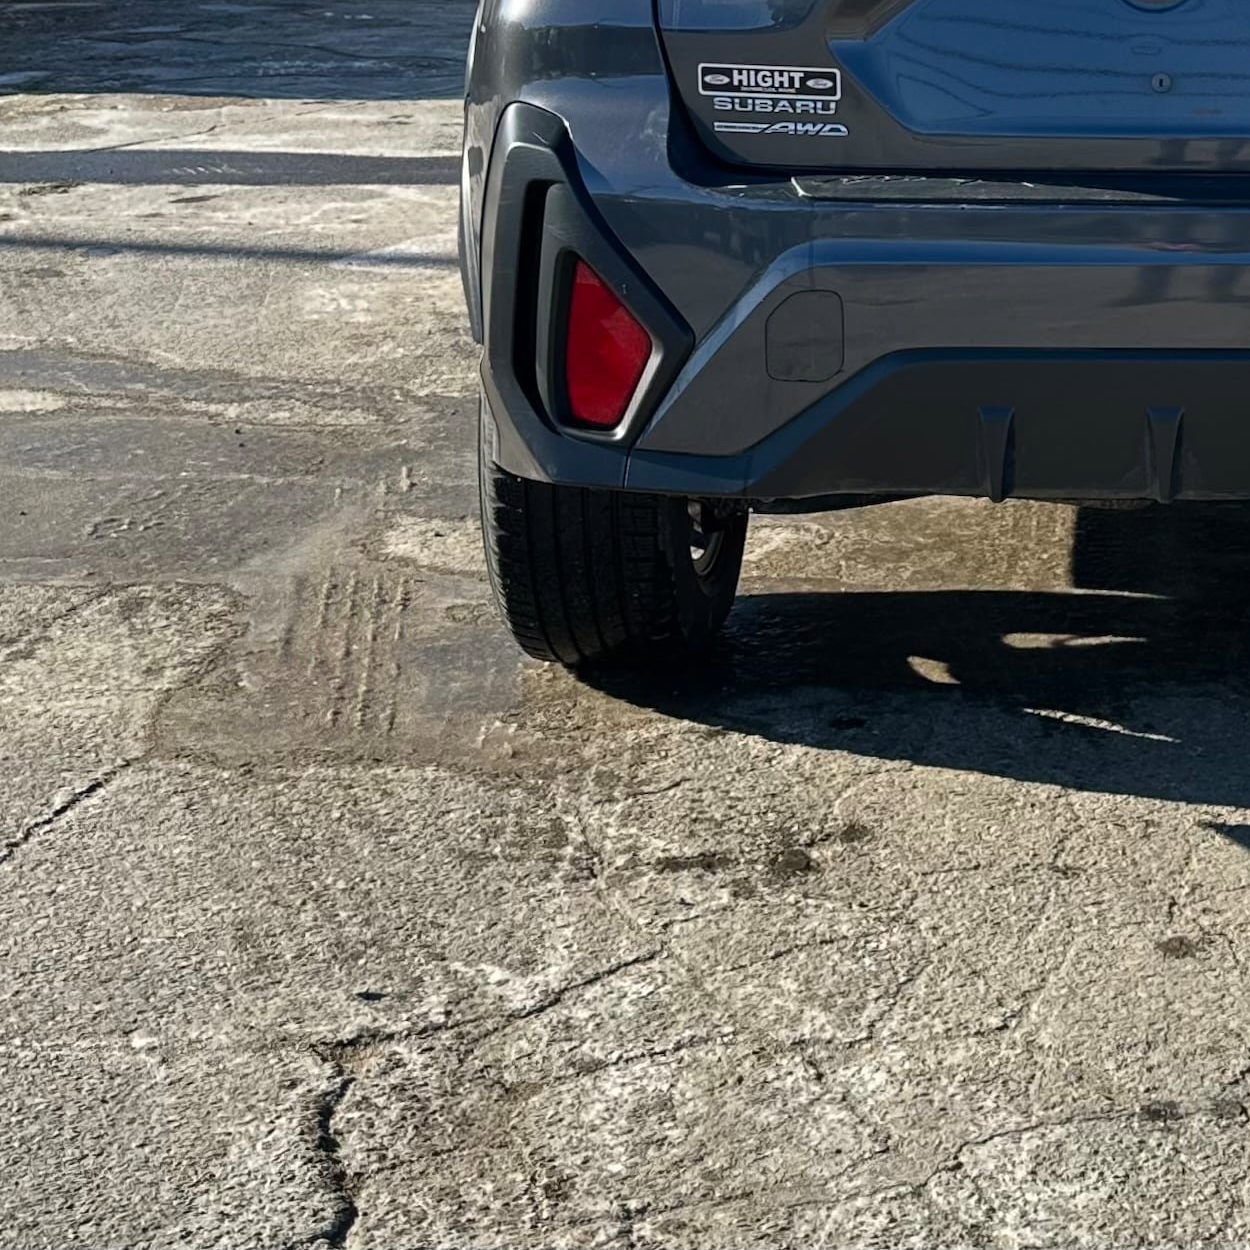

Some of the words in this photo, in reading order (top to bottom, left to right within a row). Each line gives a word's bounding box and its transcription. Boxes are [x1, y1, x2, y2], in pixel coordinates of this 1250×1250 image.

[733, 70, 805, 88] HIGHT
[713, 97, 837, 115] SUBARU
[764, 121, 849, 137] AWD
